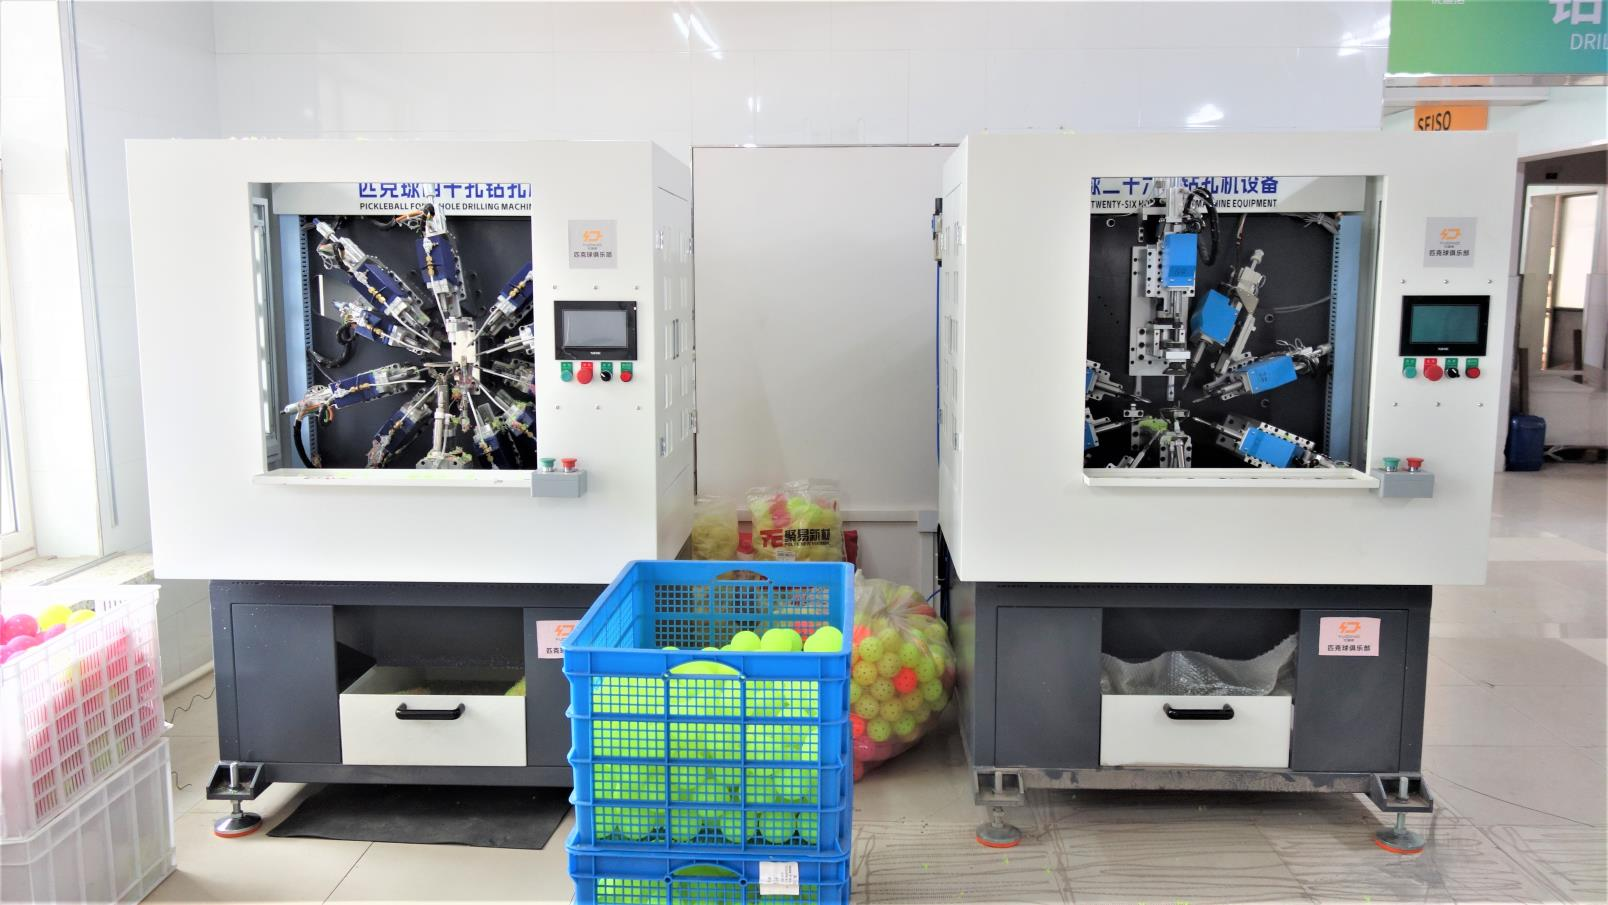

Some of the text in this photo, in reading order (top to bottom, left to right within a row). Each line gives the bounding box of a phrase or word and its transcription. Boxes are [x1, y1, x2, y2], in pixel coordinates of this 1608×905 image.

[360, 202, 409, 210] PICKLEBALL
[462, 202, 500, 211] DRILLING
[1091, 200, 1137, 209] TWENTY-SIX
[1232, 199, 1278, 209] EQUIPMENT
